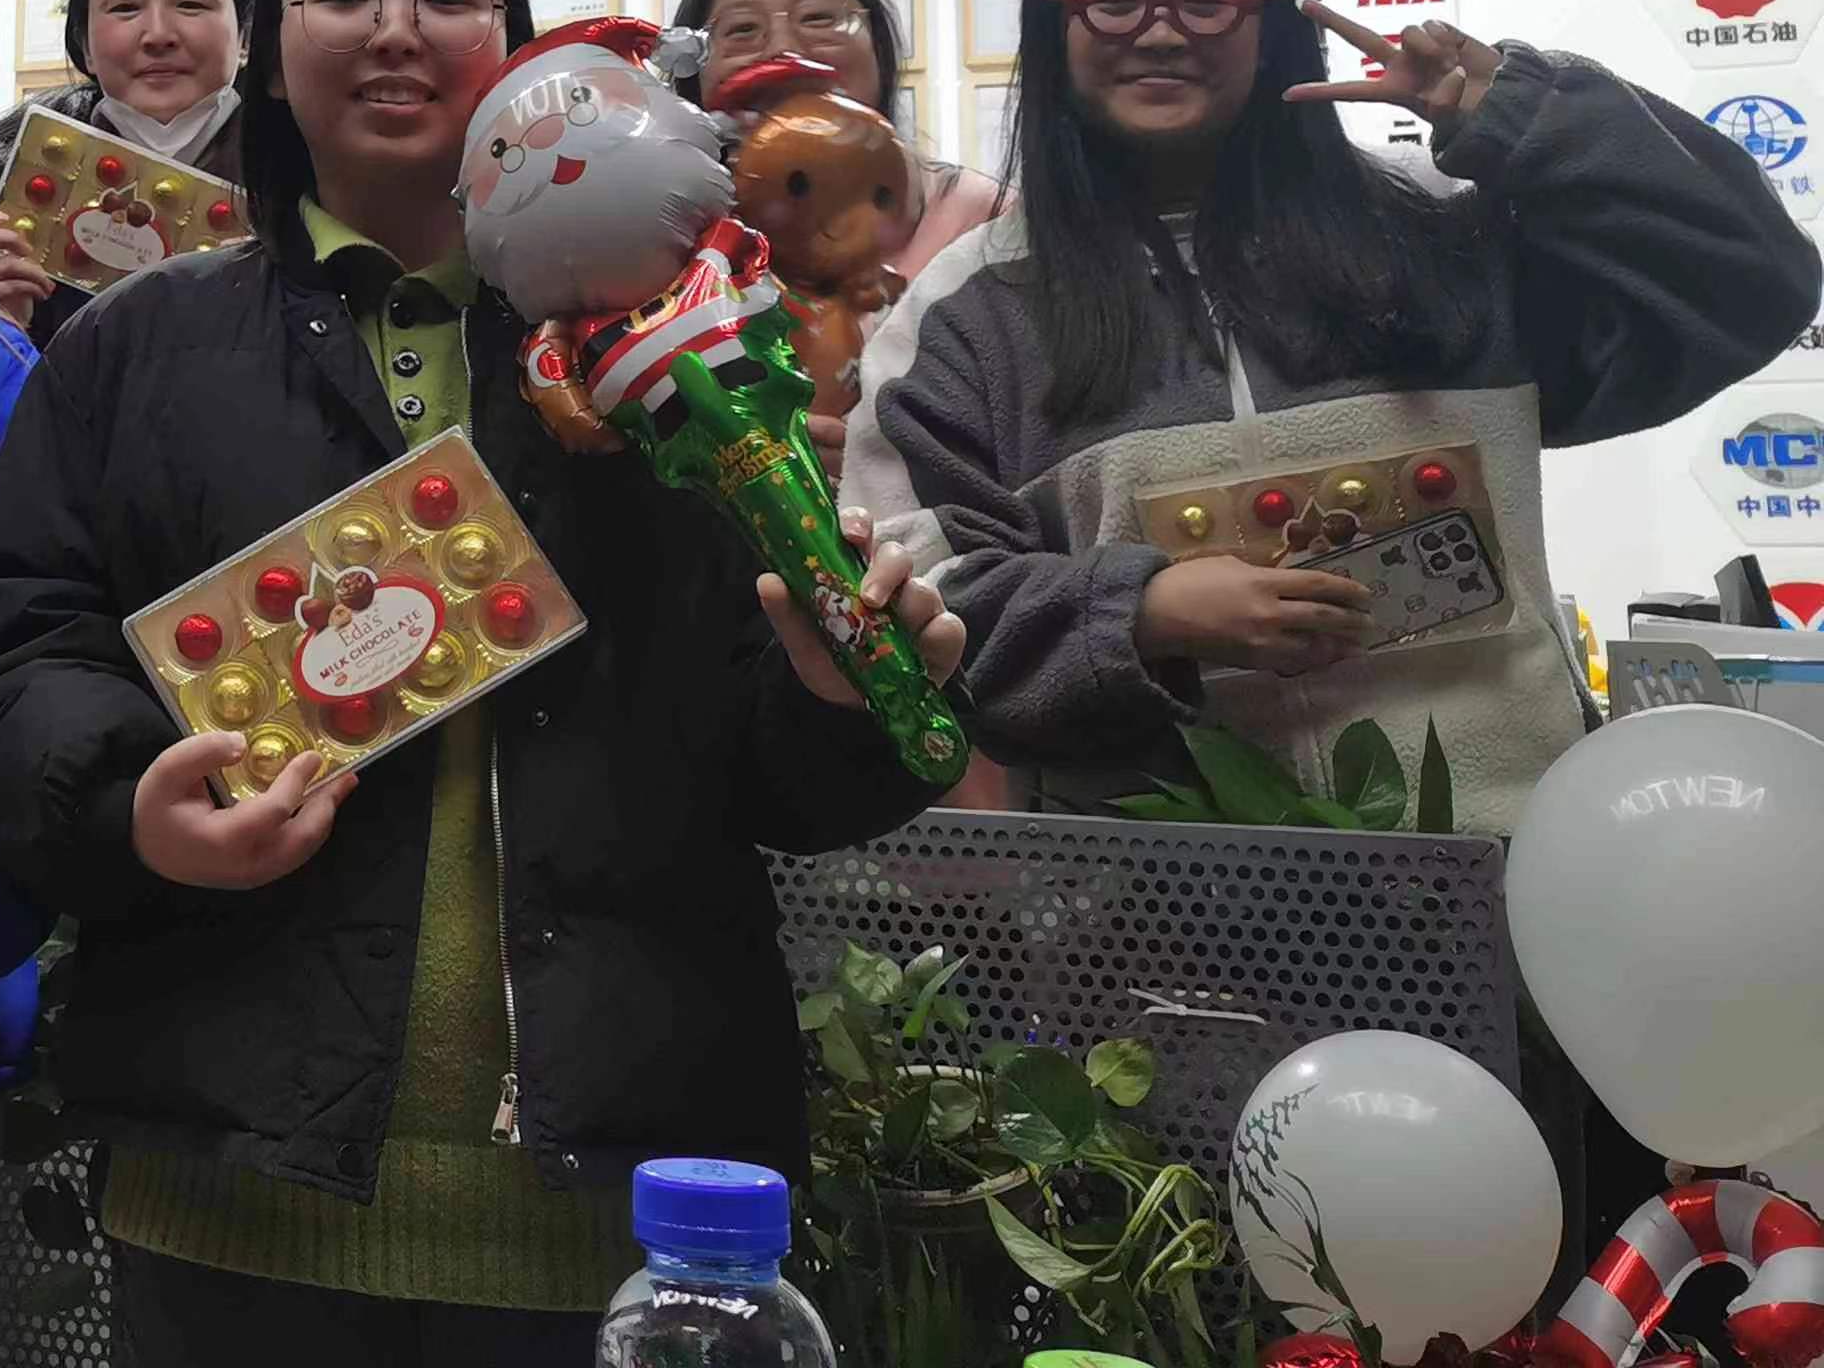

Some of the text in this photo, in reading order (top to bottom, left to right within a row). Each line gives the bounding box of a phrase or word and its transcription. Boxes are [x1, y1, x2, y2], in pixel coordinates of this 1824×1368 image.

[1686, 21, 1798, 47] 中国石油
[319, 658, 350, 680] MILK
[349, 610, 423, 661] CHOCOLATE
